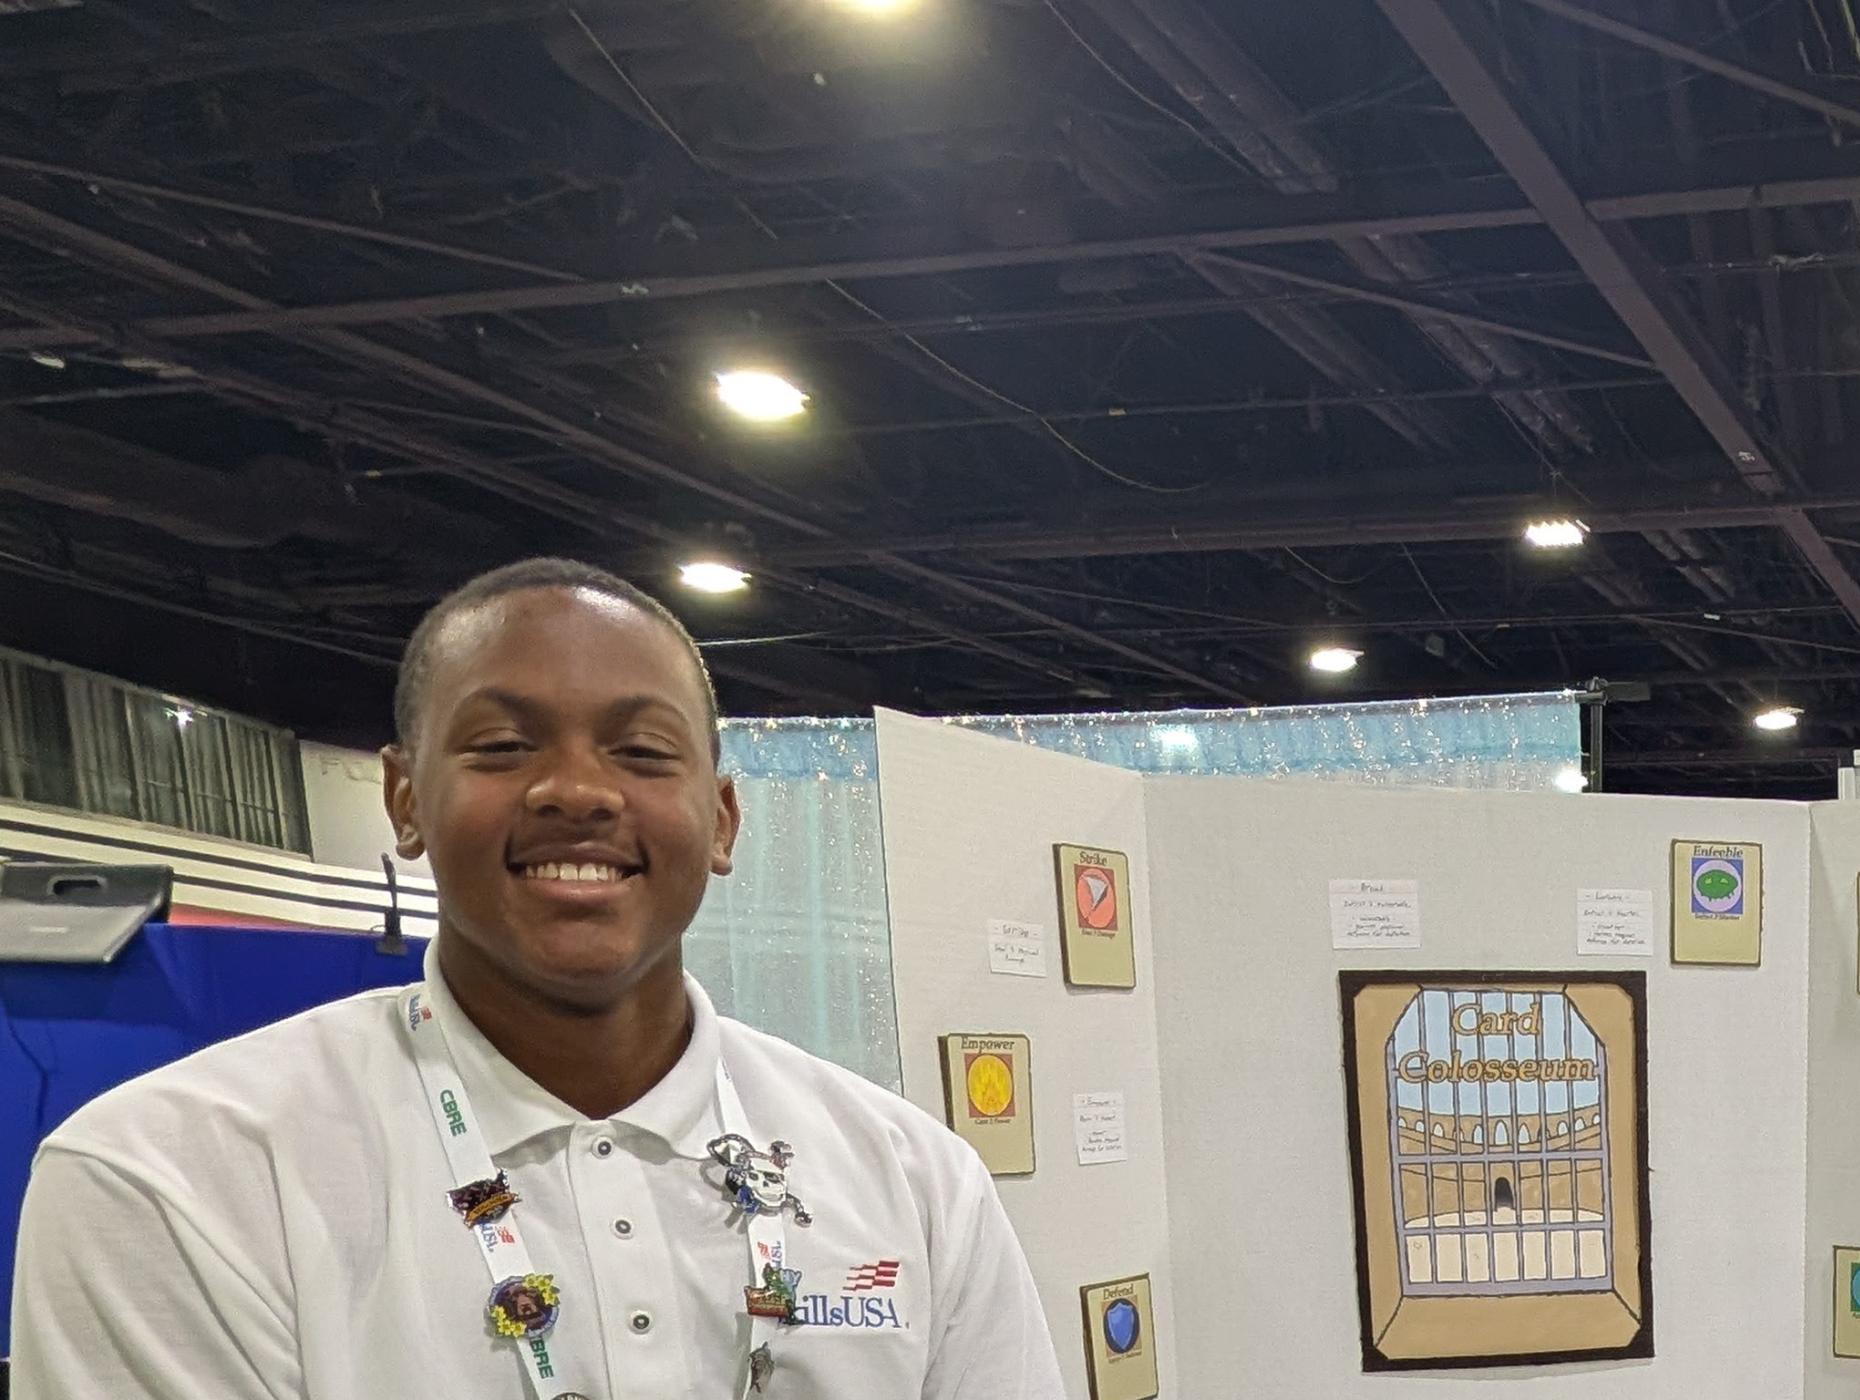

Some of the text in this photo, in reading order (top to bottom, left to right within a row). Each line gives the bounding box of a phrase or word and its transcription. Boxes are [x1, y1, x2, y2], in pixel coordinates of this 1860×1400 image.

[1079, 851, 1107, 866] Strike
[1452, 1002, 1540, 1036] Card
[961, 1036, 1015, 1053] Empower
[1399, 1051, 1597, 1083] Colosseum
[440, 1089, 467, 1137] CBRE
[1103, 1283, 1134, 1301] Defend
[793, 1295, 902, 1328] illsUSA
[530, 1337, 554, 1379] BRE
